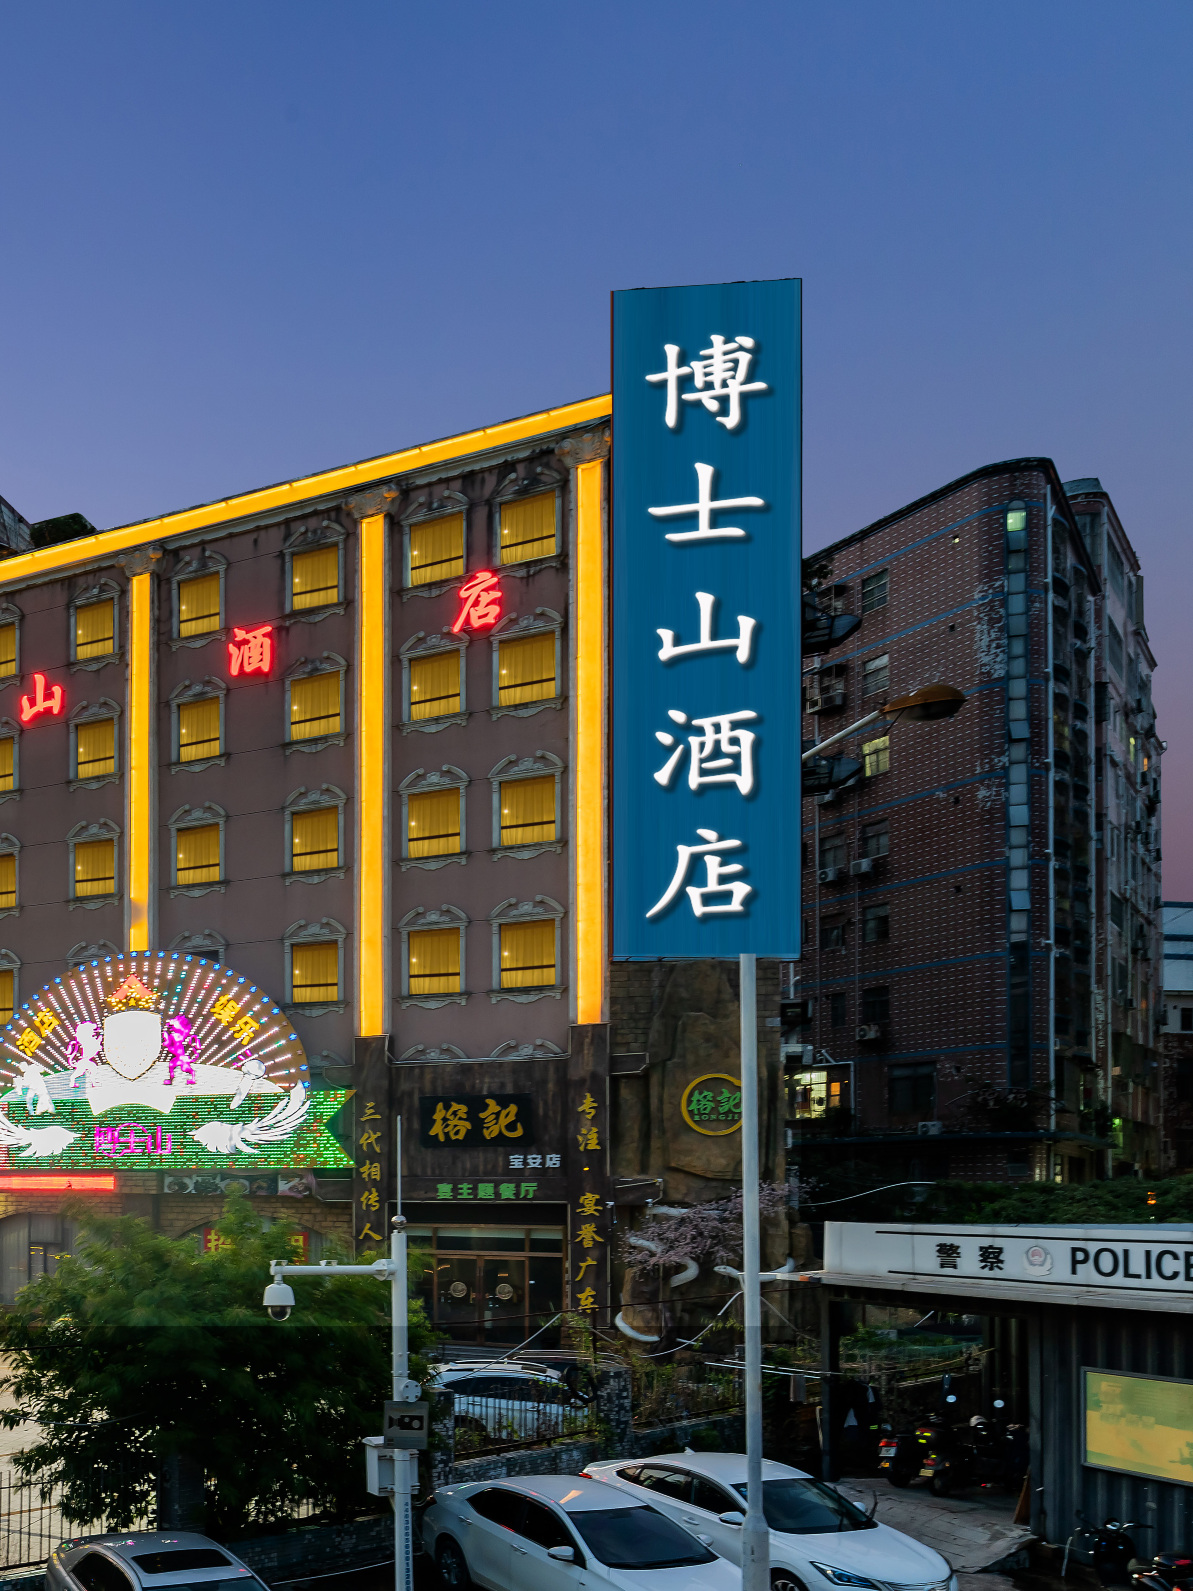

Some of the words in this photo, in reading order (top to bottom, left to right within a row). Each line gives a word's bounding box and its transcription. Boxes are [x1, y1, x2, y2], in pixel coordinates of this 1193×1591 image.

[646, 334, 768, 921] 博士山酒店
[210, 995, 250, 1045] 娱乐
[94, 1123, 172, 1157] 博士山
[509, 1153, 561, 1169] 宝安店
[935, 1242, 1006, 1272] 警察
